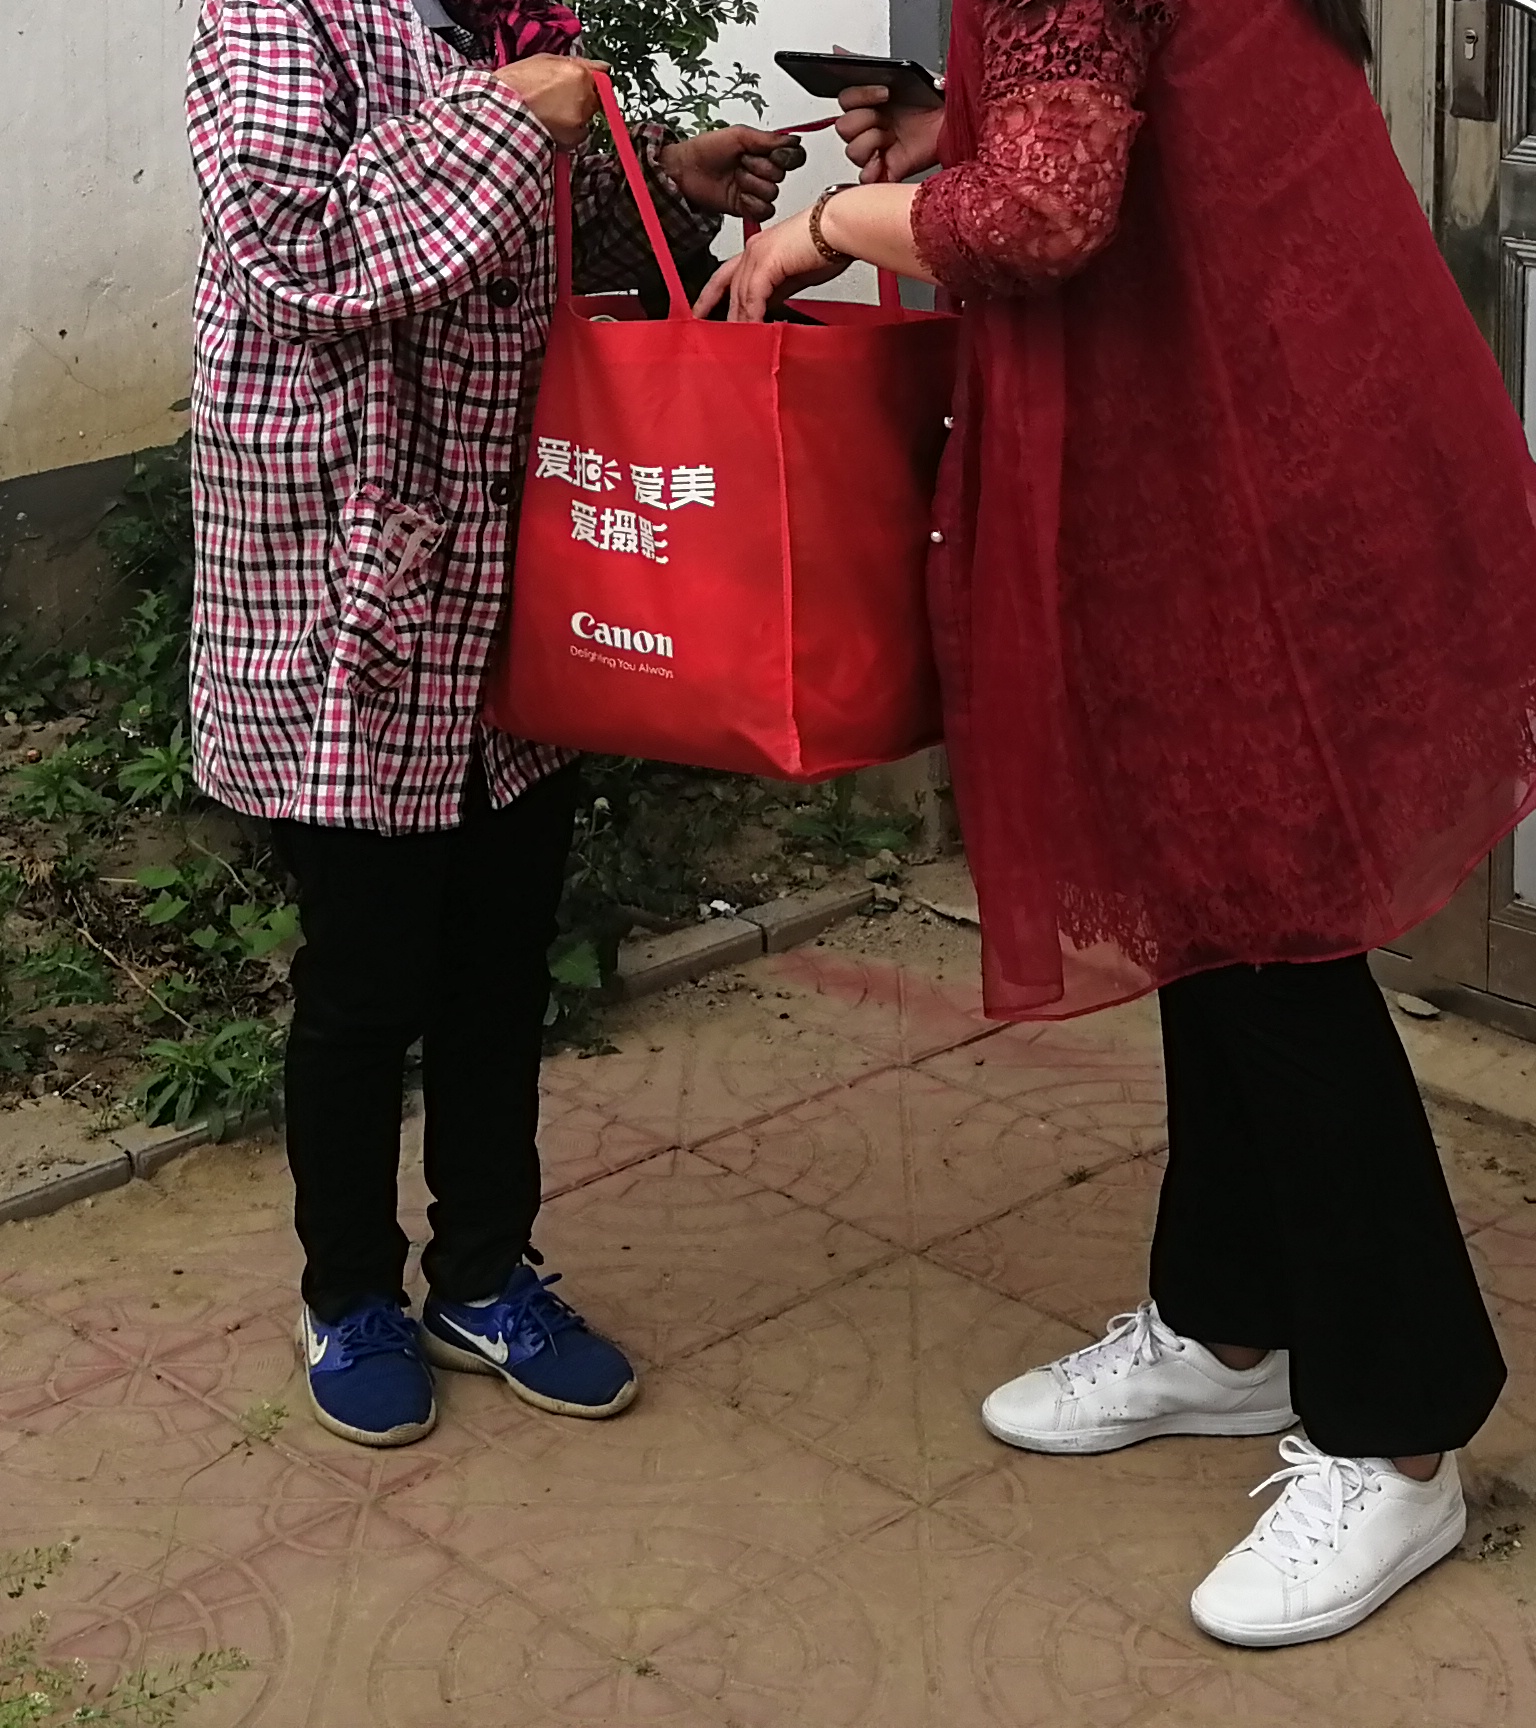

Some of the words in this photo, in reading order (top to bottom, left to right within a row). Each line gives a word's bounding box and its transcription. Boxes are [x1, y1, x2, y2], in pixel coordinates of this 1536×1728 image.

[571, 499, 669, 564] 爱摄影
[571, 611, 673, 658] Canon
